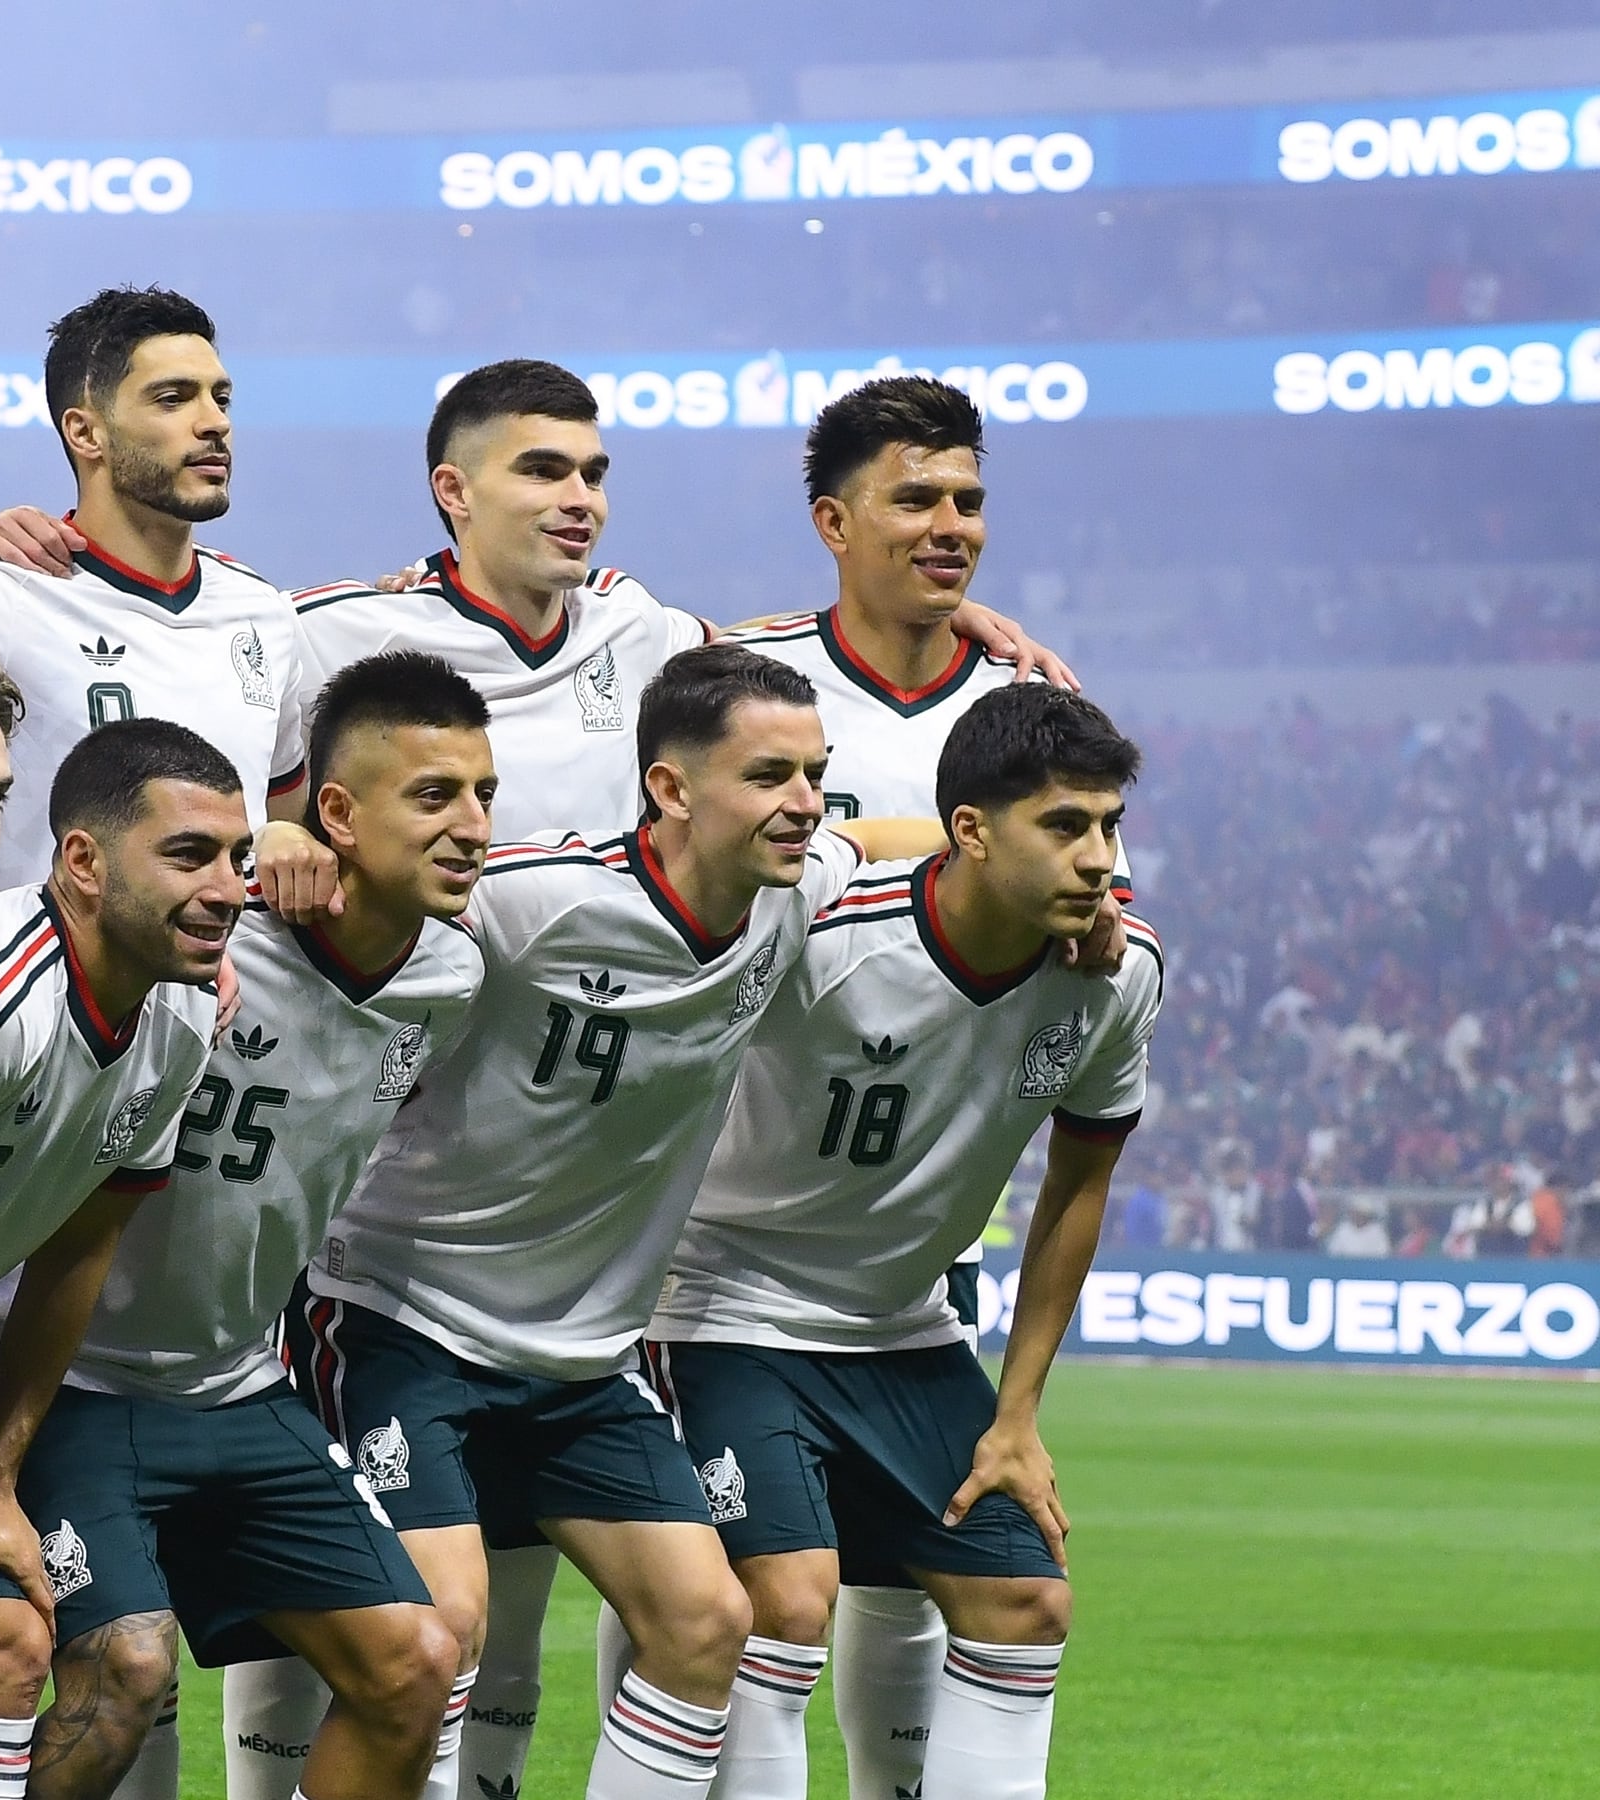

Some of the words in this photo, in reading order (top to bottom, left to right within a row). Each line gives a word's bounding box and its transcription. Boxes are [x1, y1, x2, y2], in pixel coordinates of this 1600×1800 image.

[440, 144, 735, 209] SOMOS
[798, 128, 1094, 197] MÉXICO
[1278, 109, 1571, 183] SOMOS
[1273, 341, 1566, 415] SOMOS
[531, 1001, 632, 1106] 19
[173, 1073, 290, 1185] 25
[818, 1077, 911, 1168] 18
[1079, 1269, 1600, 1361] ESFUERZO
[371, 1475, 406, 1490] ÉXICO
[711, 1506, 743, 1523] ÉXICO
[471, 1707, 537, 1726] MÉXIC
